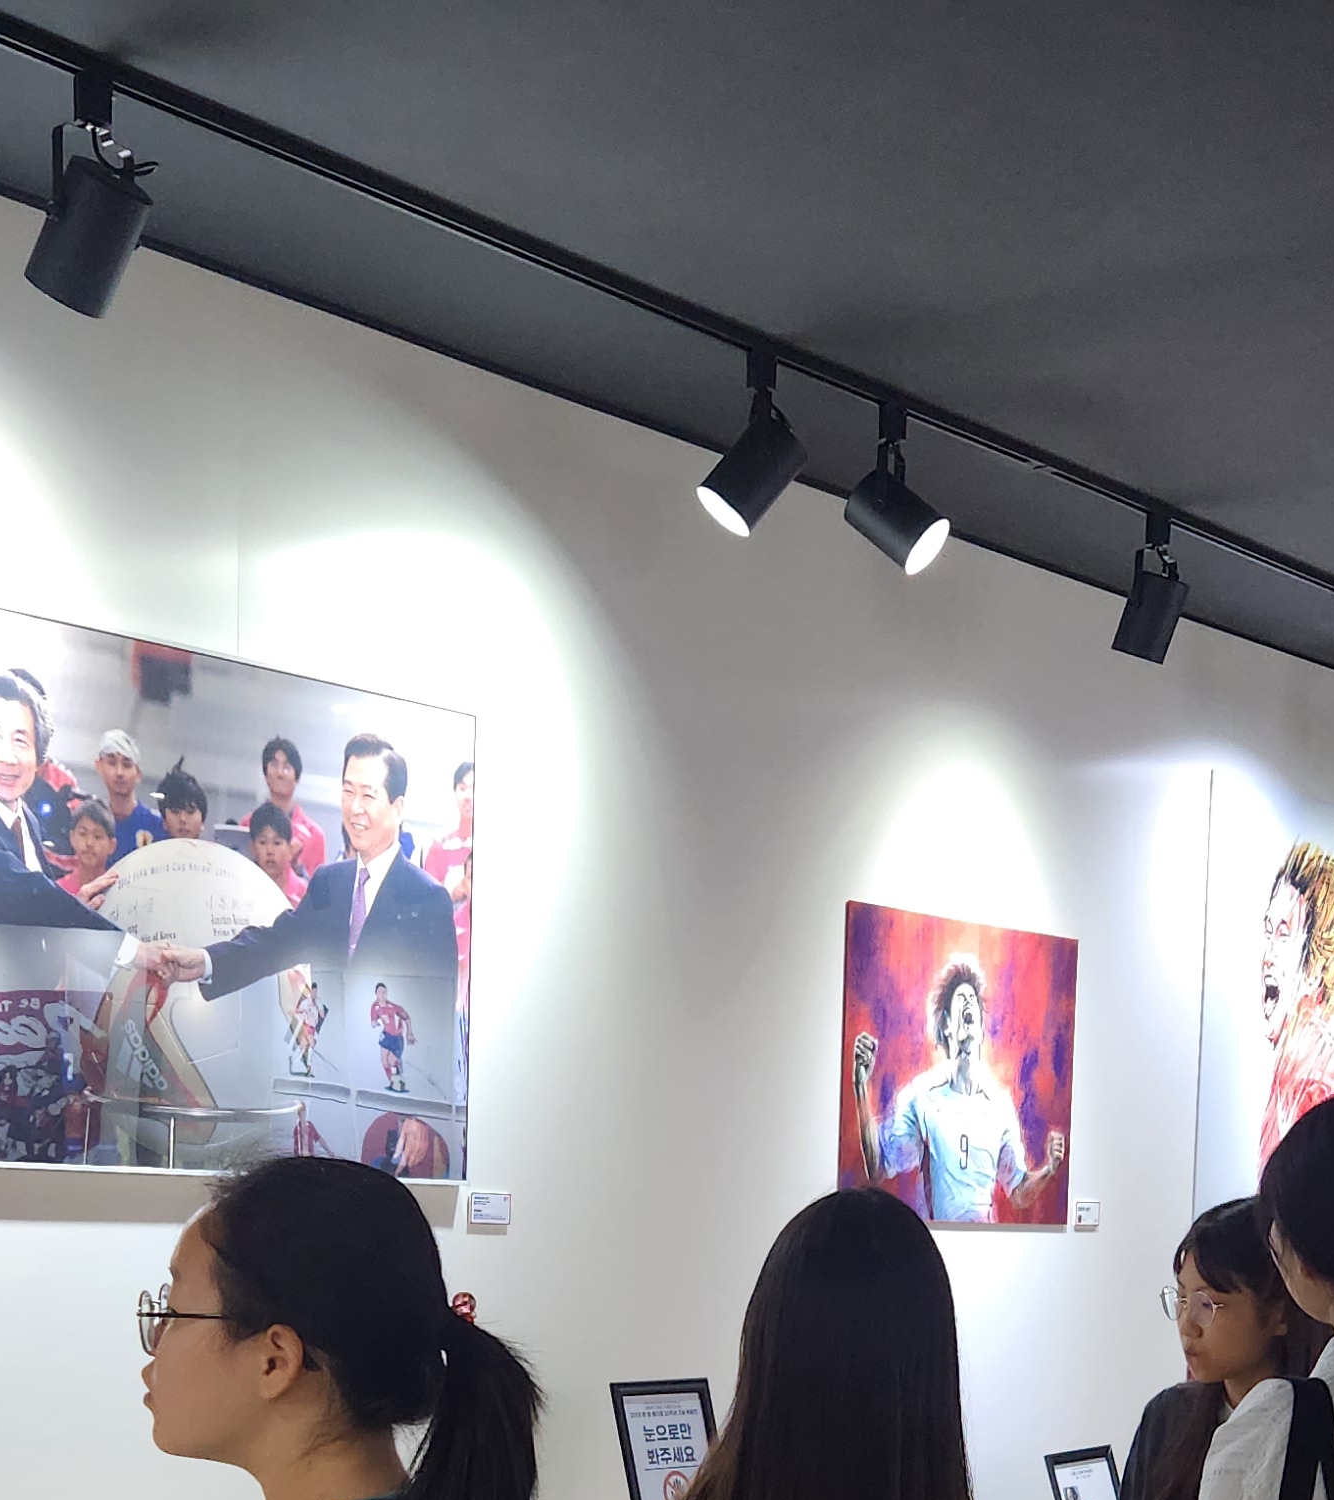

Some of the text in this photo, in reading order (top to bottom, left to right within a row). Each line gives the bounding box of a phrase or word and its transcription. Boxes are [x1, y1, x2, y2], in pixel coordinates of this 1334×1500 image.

[124, 1018, 168, 1091] adidas
[959, 1133, 969, 1170] 9
[643, 1423, 692, 1442] 눈으로만
[647, 1446, 696, 1465] 봐주세요
